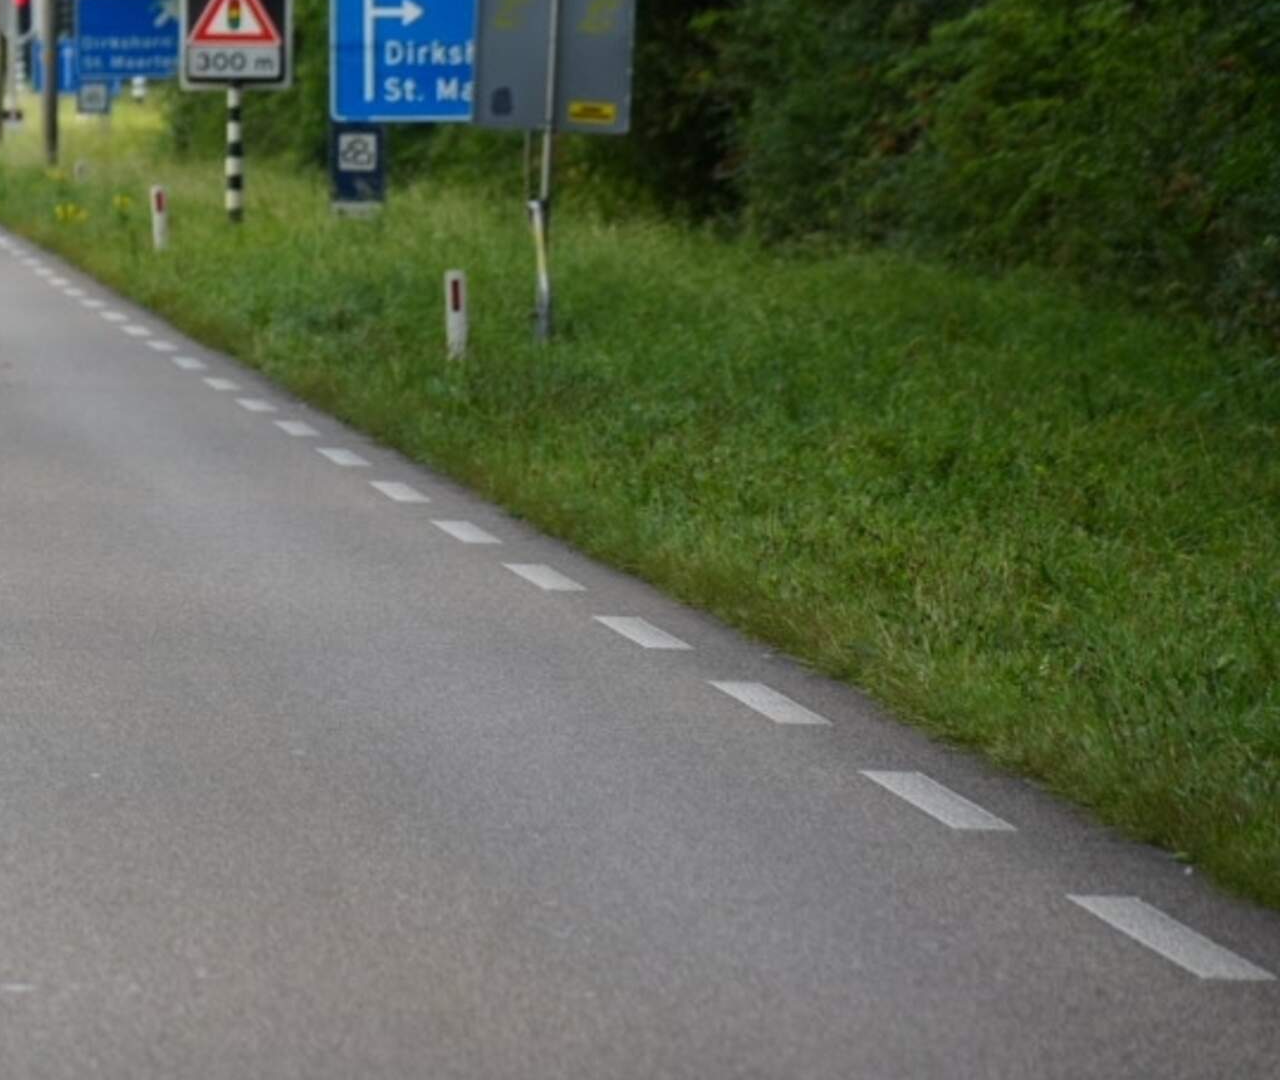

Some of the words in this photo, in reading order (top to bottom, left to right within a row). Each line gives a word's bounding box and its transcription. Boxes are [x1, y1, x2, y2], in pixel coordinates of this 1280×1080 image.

[196, 51, 247, 72] 300
[254, 56, 274, 71] m
[384, 78, 424, 102] St.
